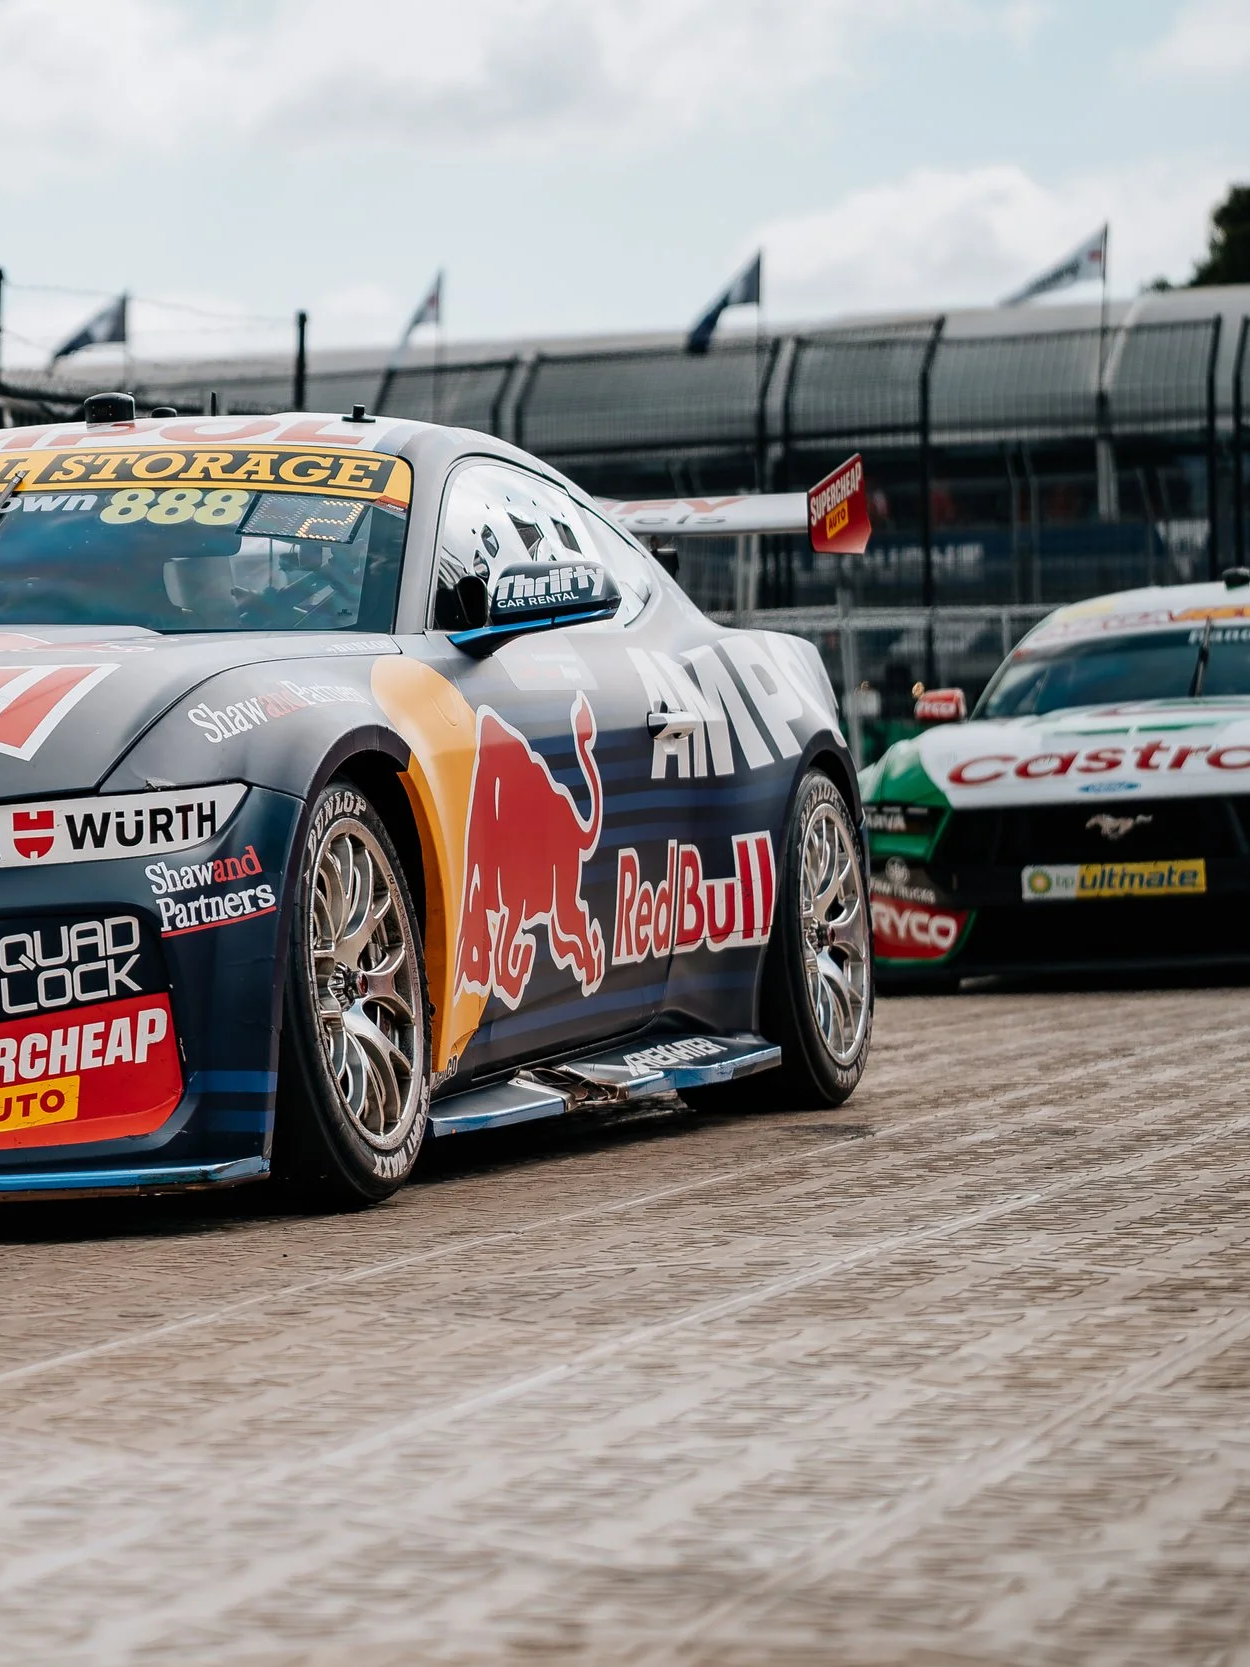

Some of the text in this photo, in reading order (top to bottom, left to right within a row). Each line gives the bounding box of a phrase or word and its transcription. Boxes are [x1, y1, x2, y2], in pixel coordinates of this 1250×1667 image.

[48, 451, 386, 491] STORAGE
[0, 489, 249, 525] own 888
[810, 461, 862, 527] SUPERCHEAP
[828, 508, 847, 530] AUTO
[496, 565, 605, 600] Thrifty
[497, 591, 580, 609] CAR RENTAL
[947, 740, 1250, 785] Castro
[66, 799, 217, 851] WÜRTH
[306, 790, 368, 870] DUNLOP
[1080, 865, 1200, 891] ultimate
[154, 882, 276, 933] Partners
[0, 953, 143, 1015] LOCK
